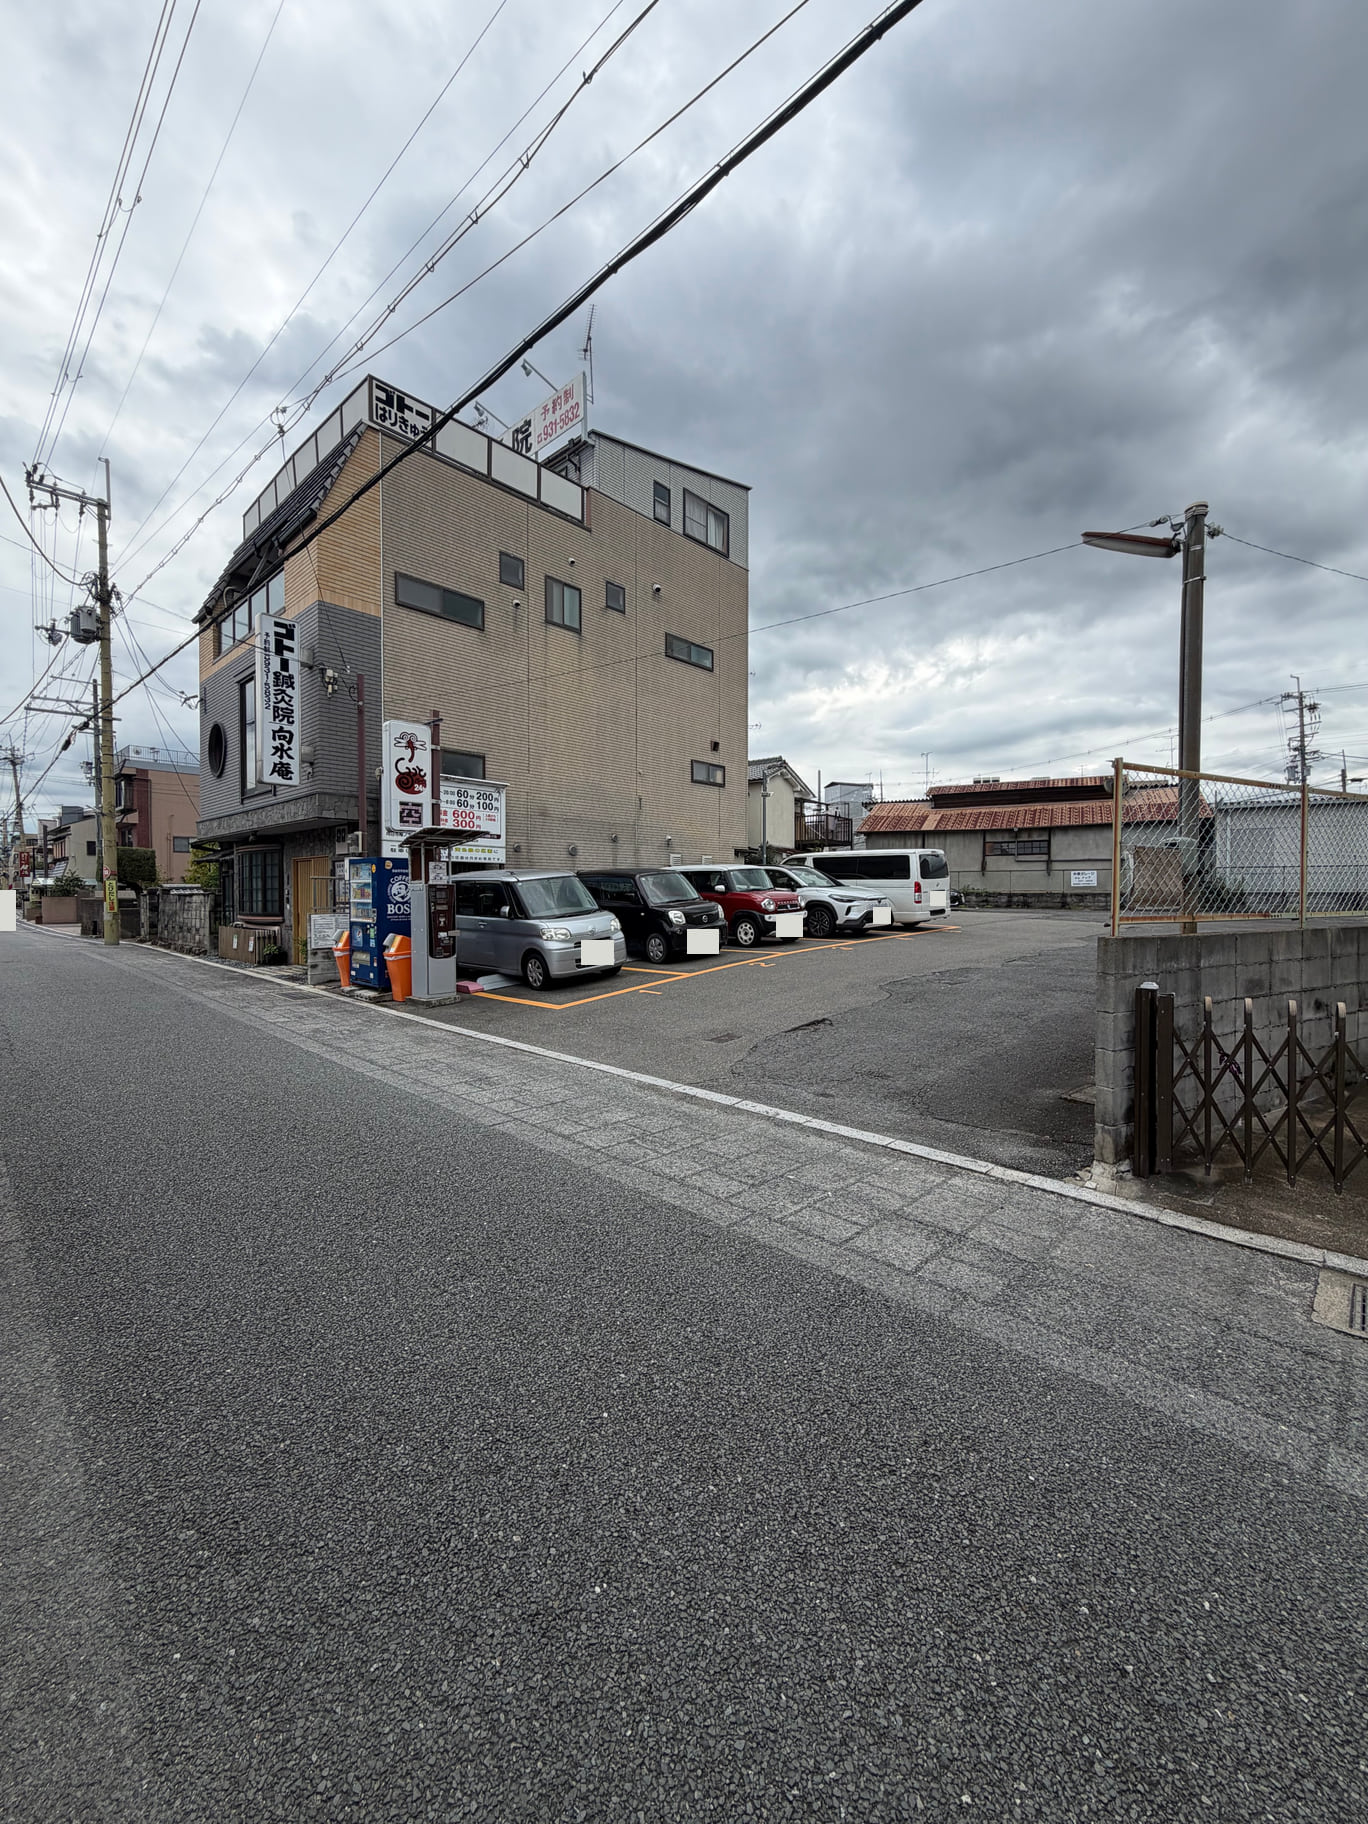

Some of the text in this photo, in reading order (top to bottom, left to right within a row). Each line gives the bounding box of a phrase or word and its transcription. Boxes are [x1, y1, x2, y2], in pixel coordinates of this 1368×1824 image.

[375, 382, 430, 422] ゴトー
[541, 383, 574, 421] 予約制
[387, 903, 411, 915] BOS
